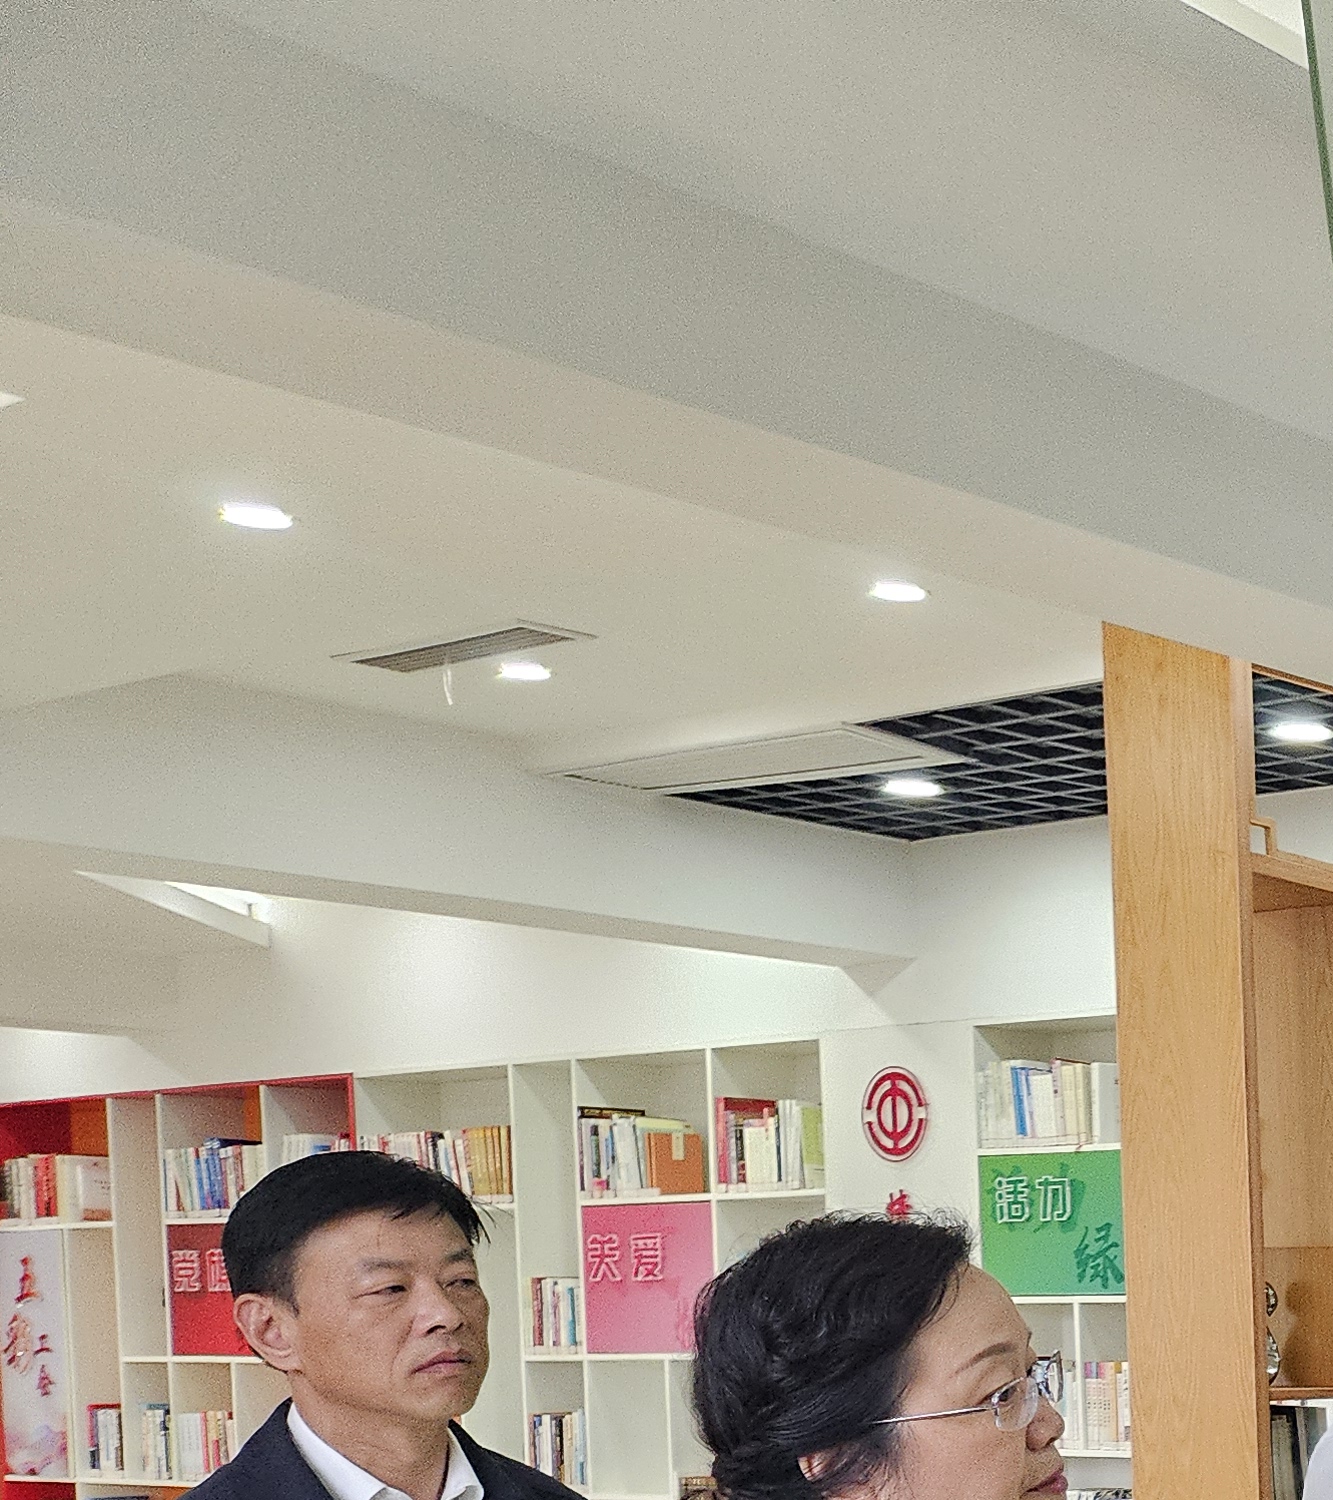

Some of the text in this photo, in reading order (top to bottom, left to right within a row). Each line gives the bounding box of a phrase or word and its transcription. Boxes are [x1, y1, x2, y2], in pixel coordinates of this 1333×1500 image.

[994, 1175, 1072, 1223] 活力
[587, 1232, 664, 1283] 关爱
[1074, 1222, 1125, 1289] 绿
